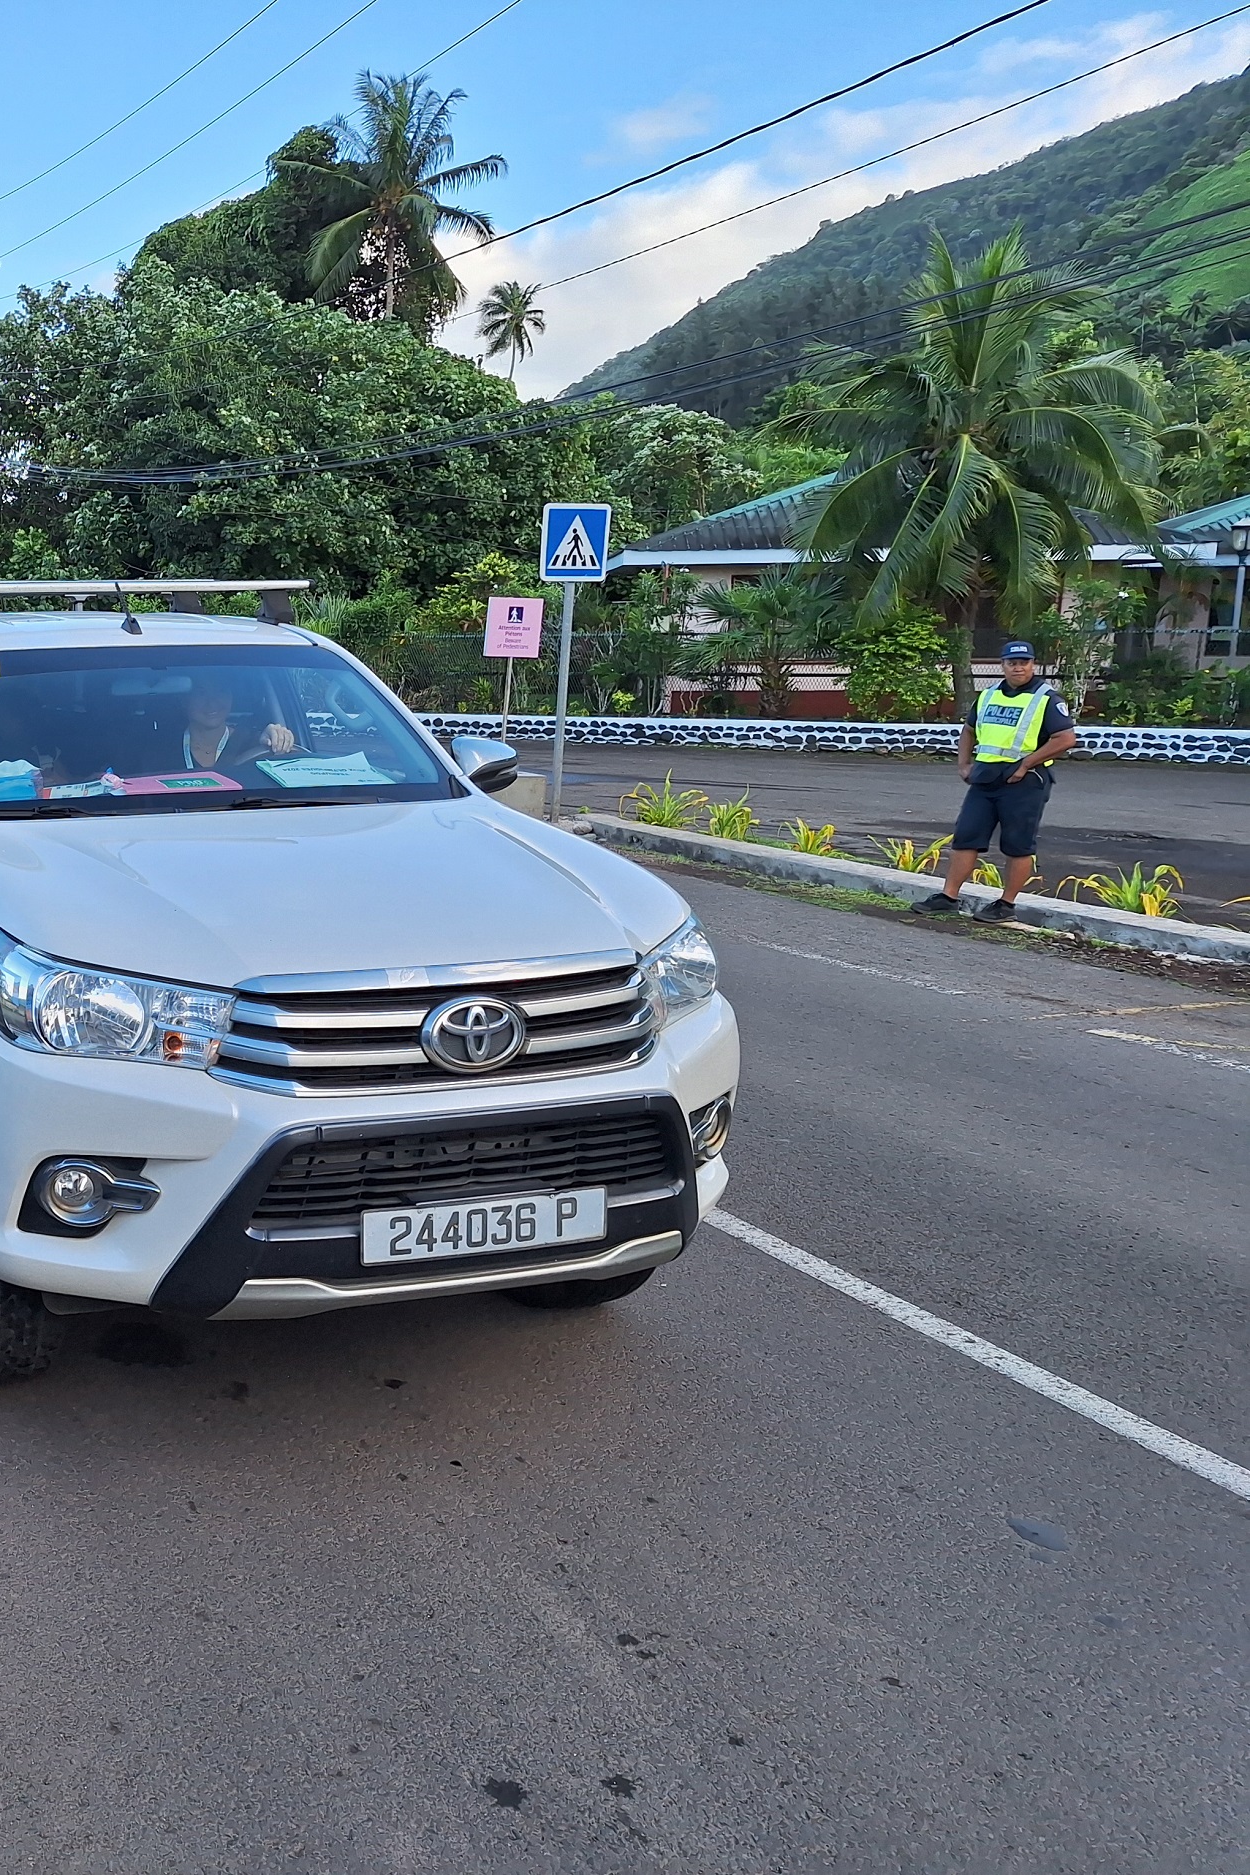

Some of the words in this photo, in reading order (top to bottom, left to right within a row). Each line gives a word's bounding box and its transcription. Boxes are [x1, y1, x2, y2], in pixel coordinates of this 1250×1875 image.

[986, 706, 1022, 718] POLICE
[983, 716, 1017, 725] MUNICIPALE
[389, 1201, 537, 1256] 244036
[555, 1196, 578, 1238] P
